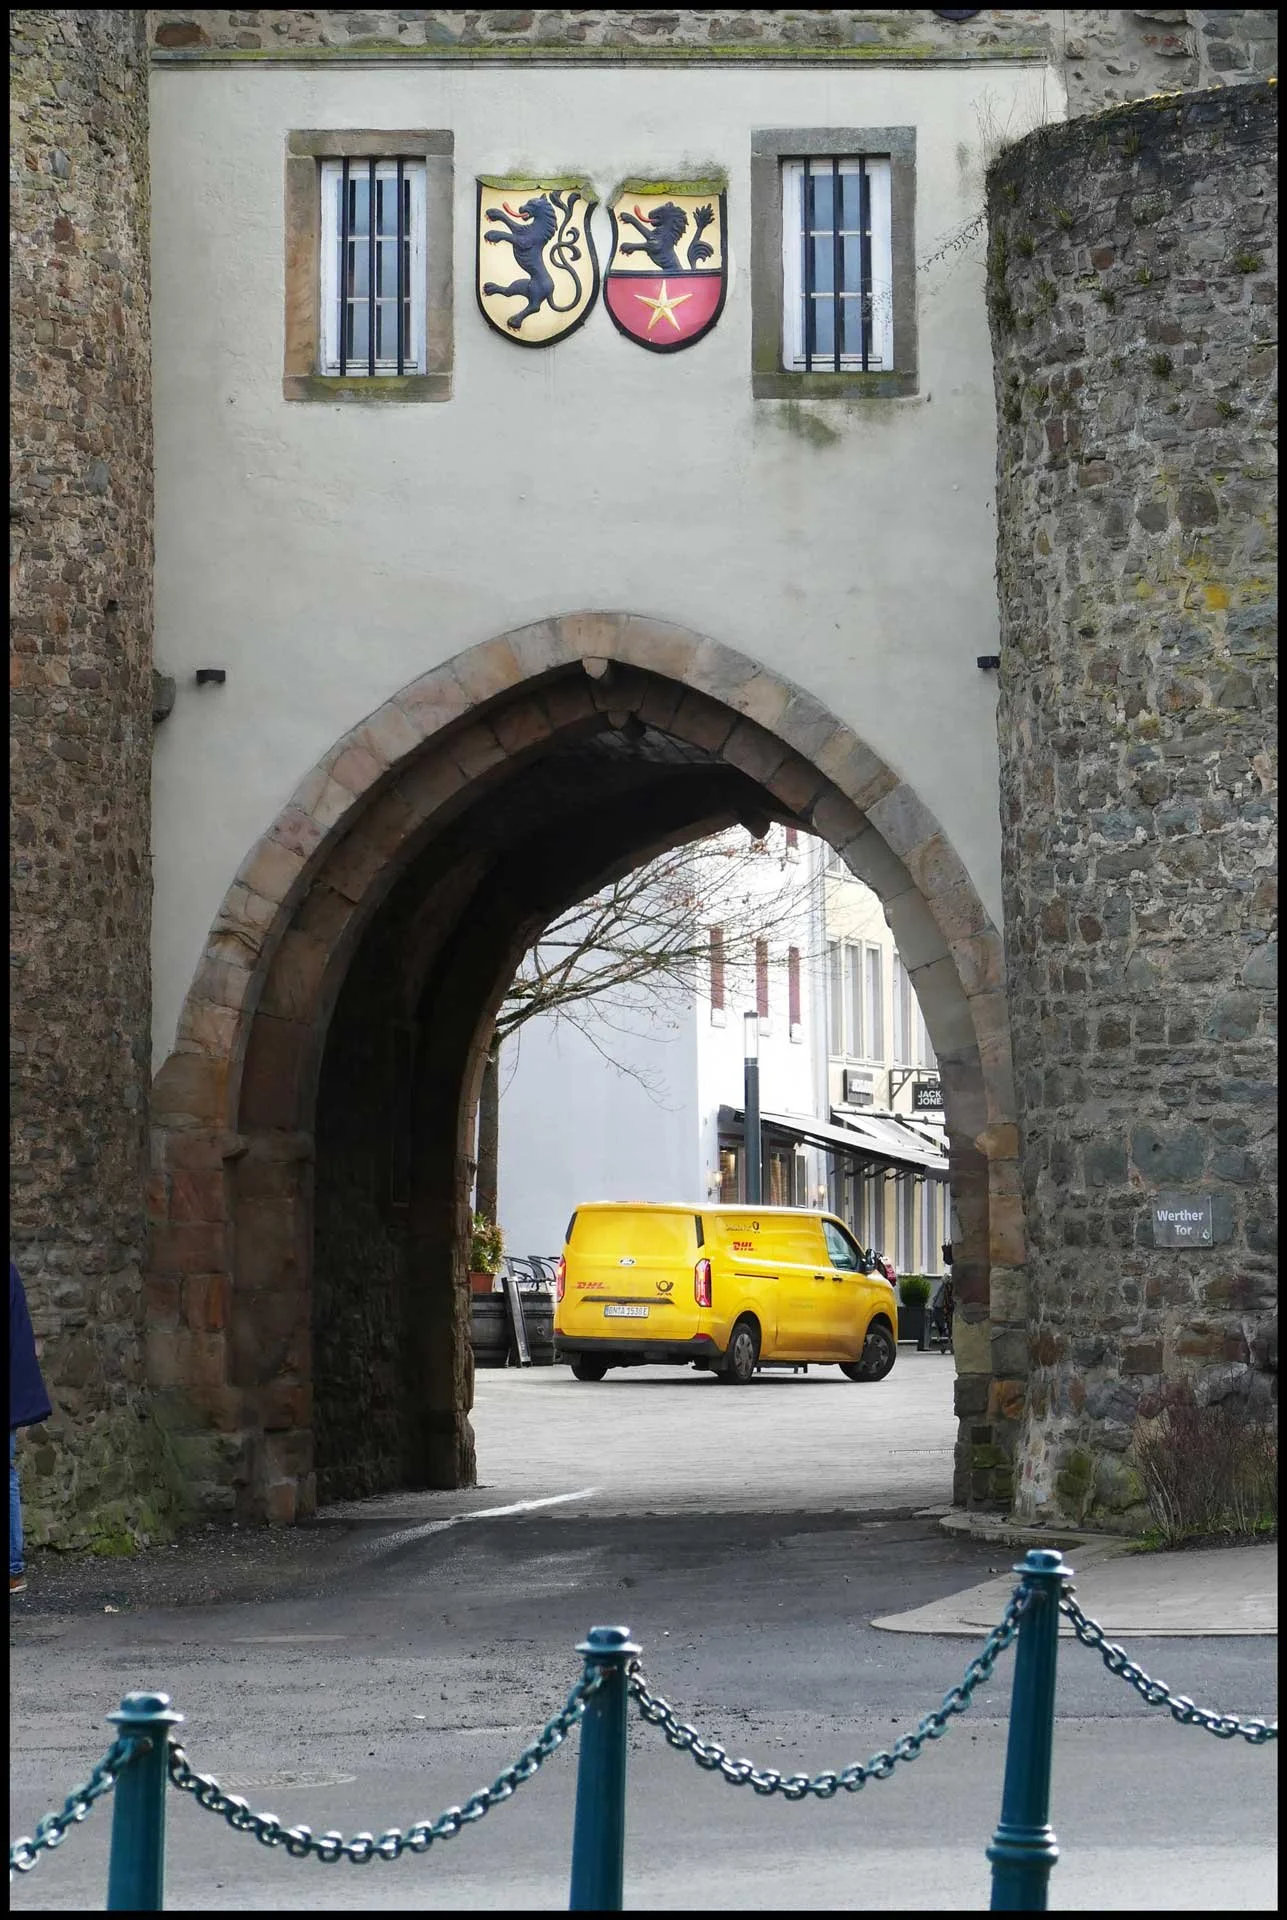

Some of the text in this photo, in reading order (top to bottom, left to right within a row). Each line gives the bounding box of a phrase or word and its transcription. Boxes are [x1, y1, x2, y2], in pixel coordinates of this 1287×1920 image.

[917, 1090, 941, 1098] JACK
[1157, 1209, 1204, 1221] Werther
[1174, 1224, 1192, 1236] Tor
[732, 1241, 754, 1251] DHL
[576, 1281, 605, 1289] DHL
